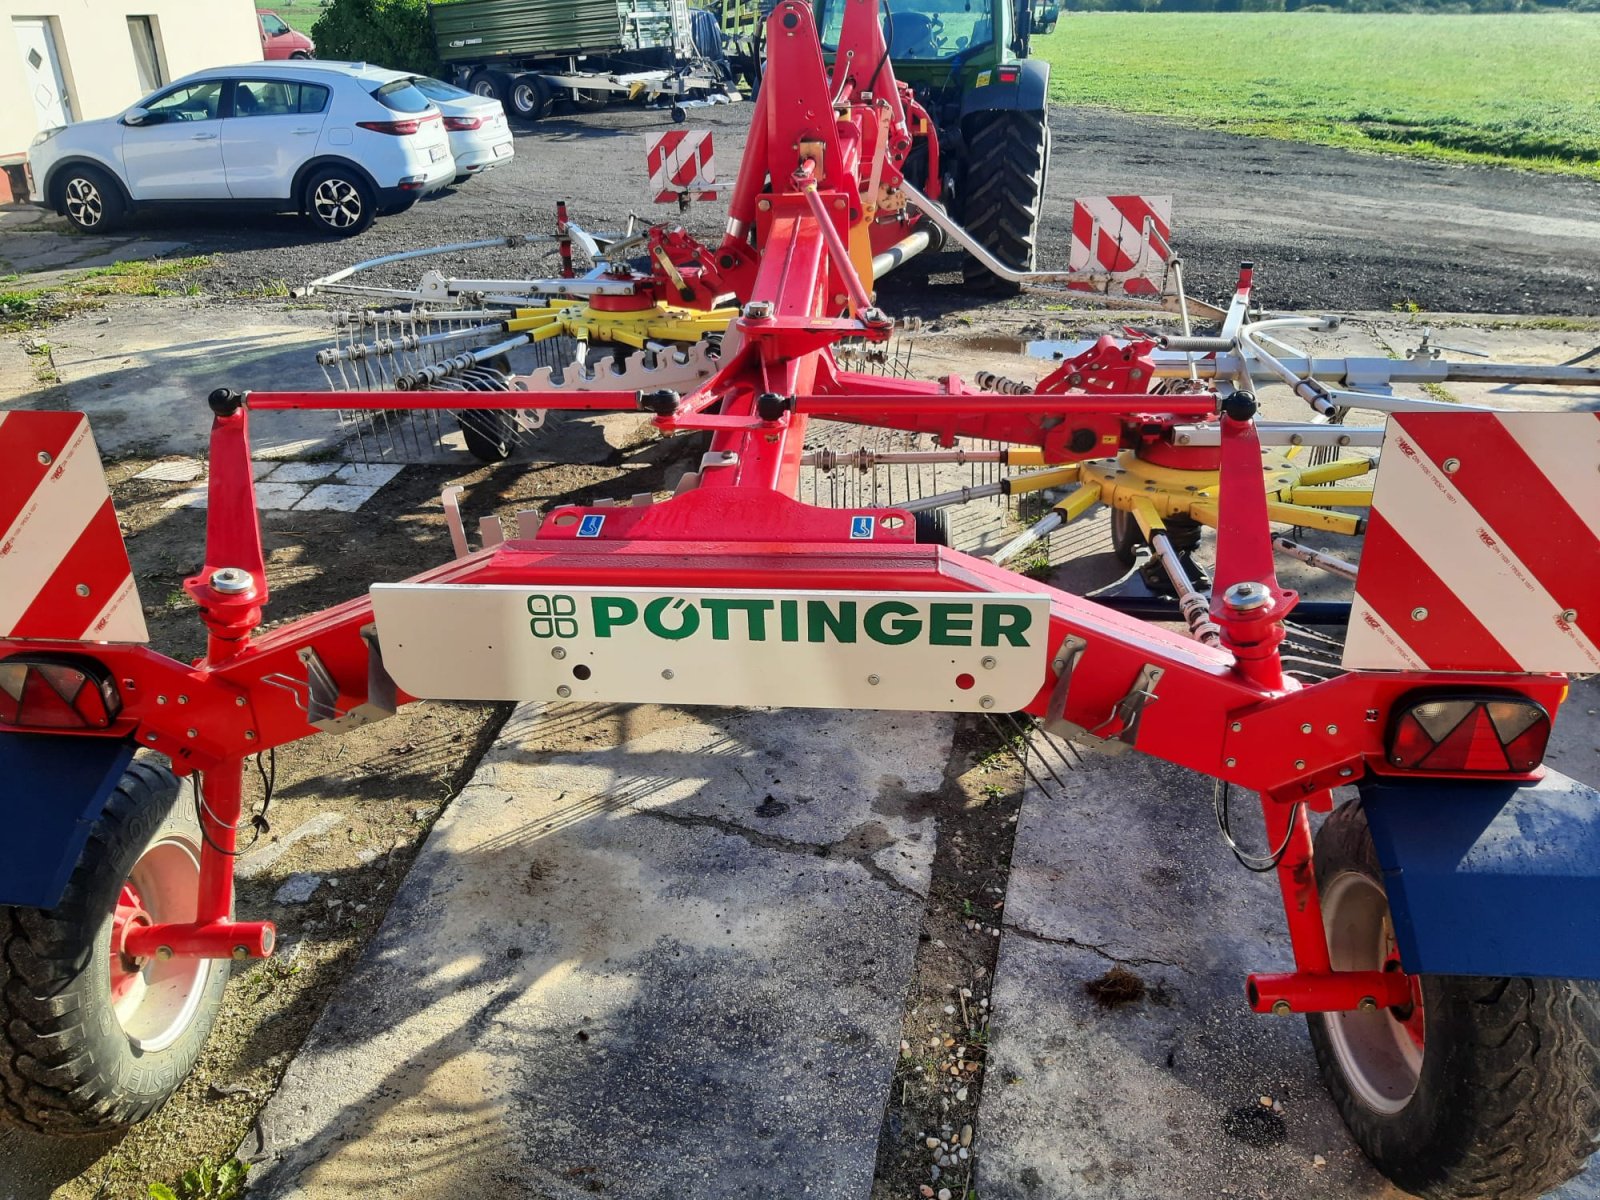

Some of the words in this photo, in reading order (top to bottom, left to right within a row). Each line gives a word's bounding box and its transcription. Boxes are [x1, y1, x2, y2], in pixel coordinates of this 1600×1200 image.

[1399, 438, 1415, 458] WGF
[1479, 530, 1496, 548] WGF
[591, 597, 1033, 647] PÖTTINGER
[1364, 613, 1381, 630] WGF
